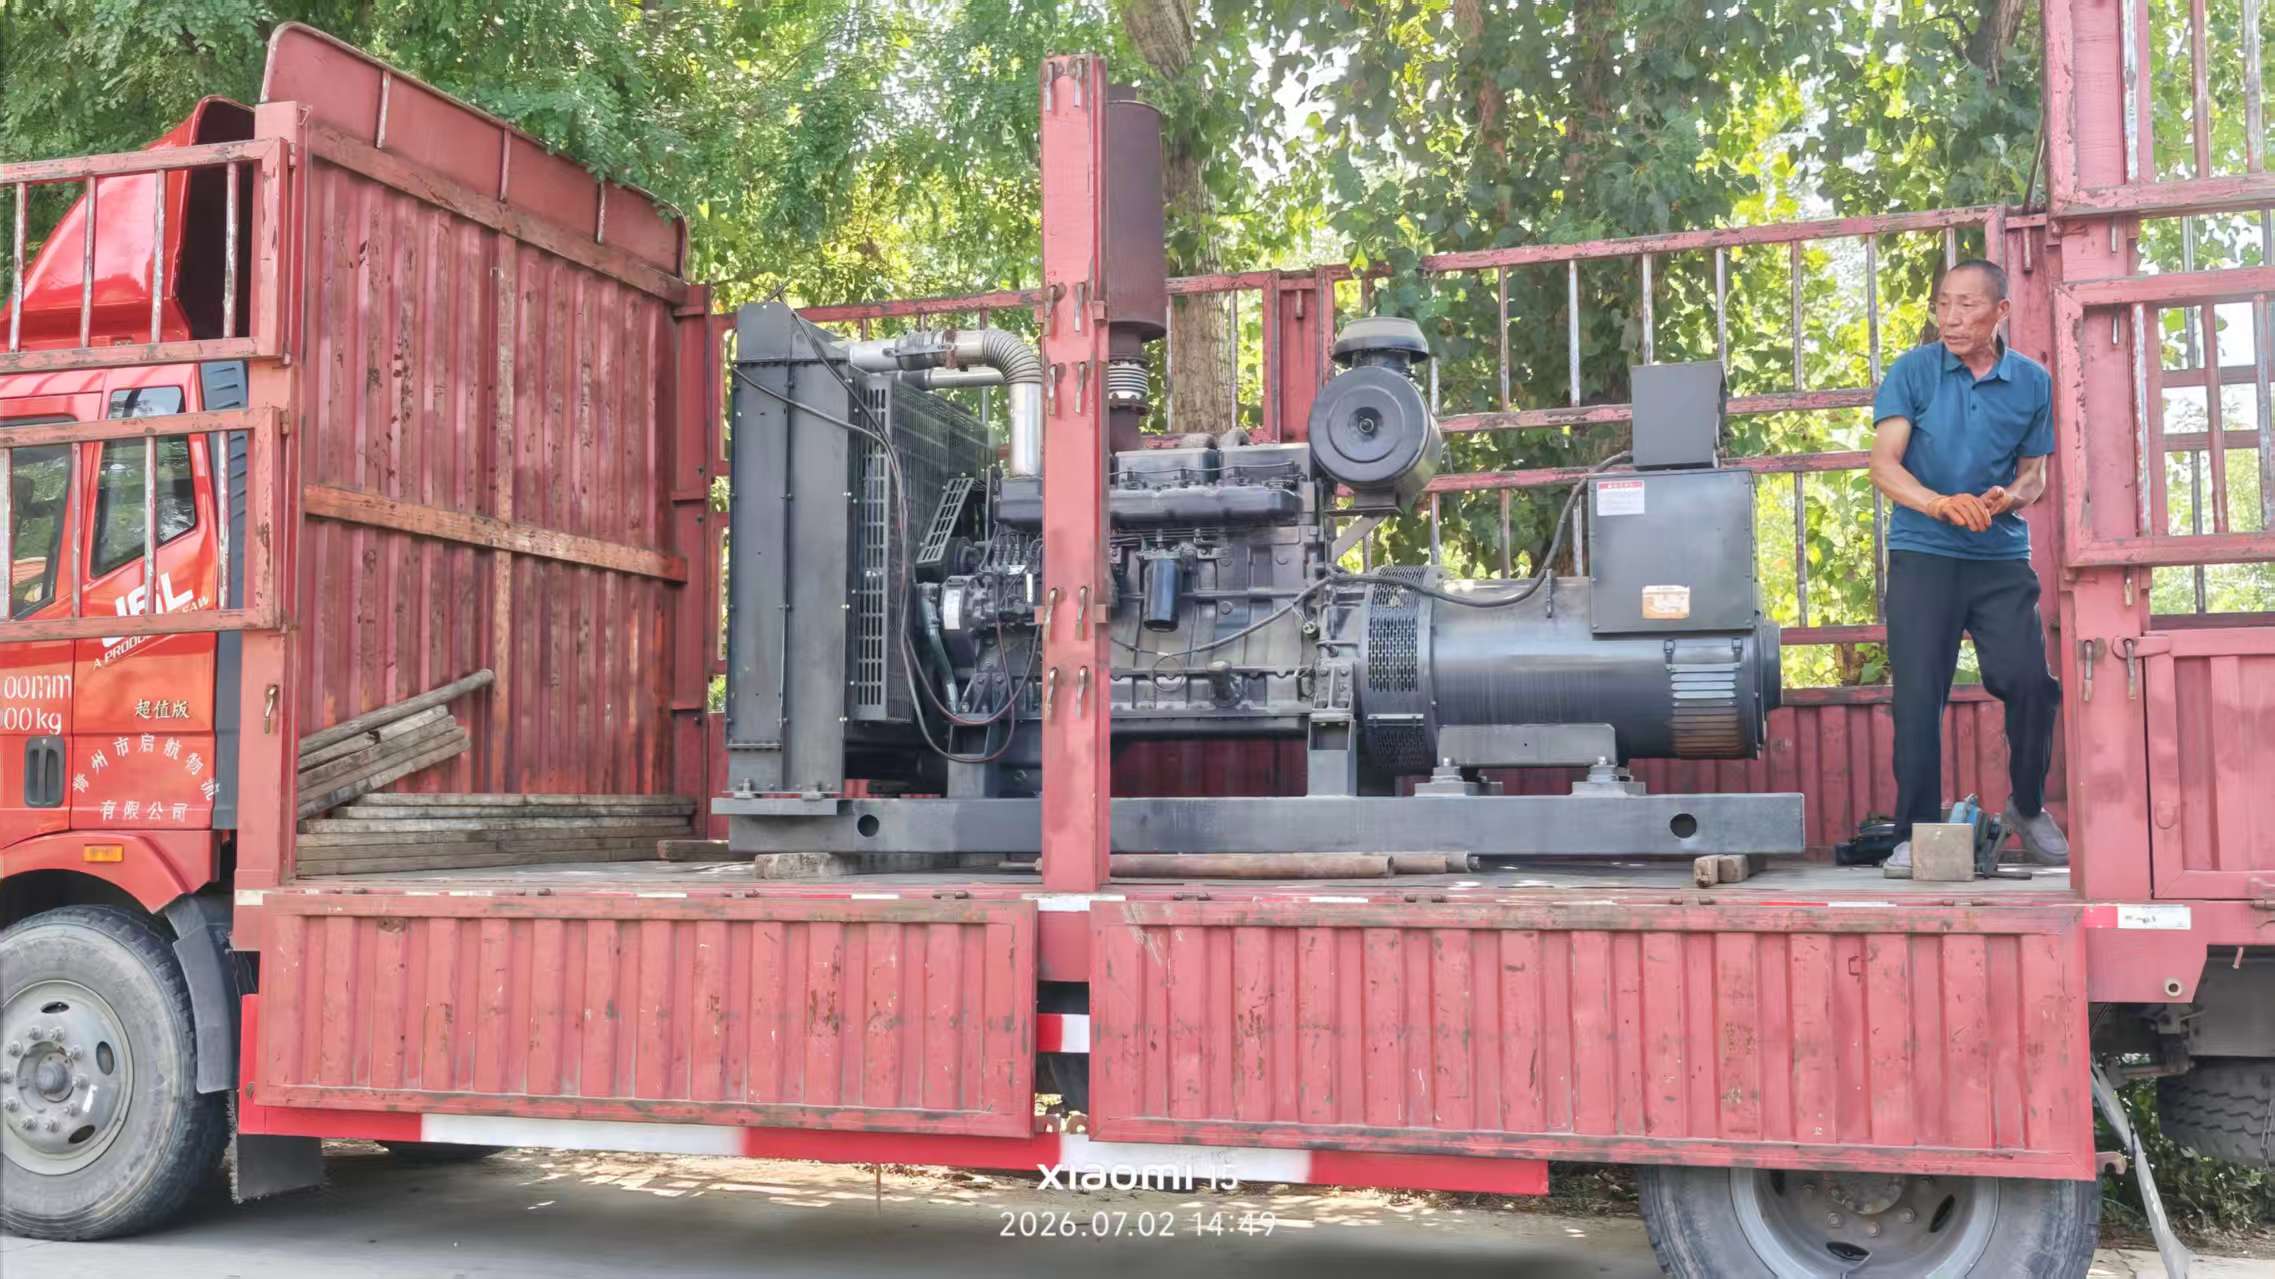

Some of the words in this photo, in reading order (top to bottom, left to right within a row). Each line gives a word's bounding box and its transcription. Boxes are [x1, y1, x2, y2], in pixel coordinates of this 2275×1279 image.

[135, 698, 190, 720] 超值版
[100, 800, 188, 823] 有限公司
